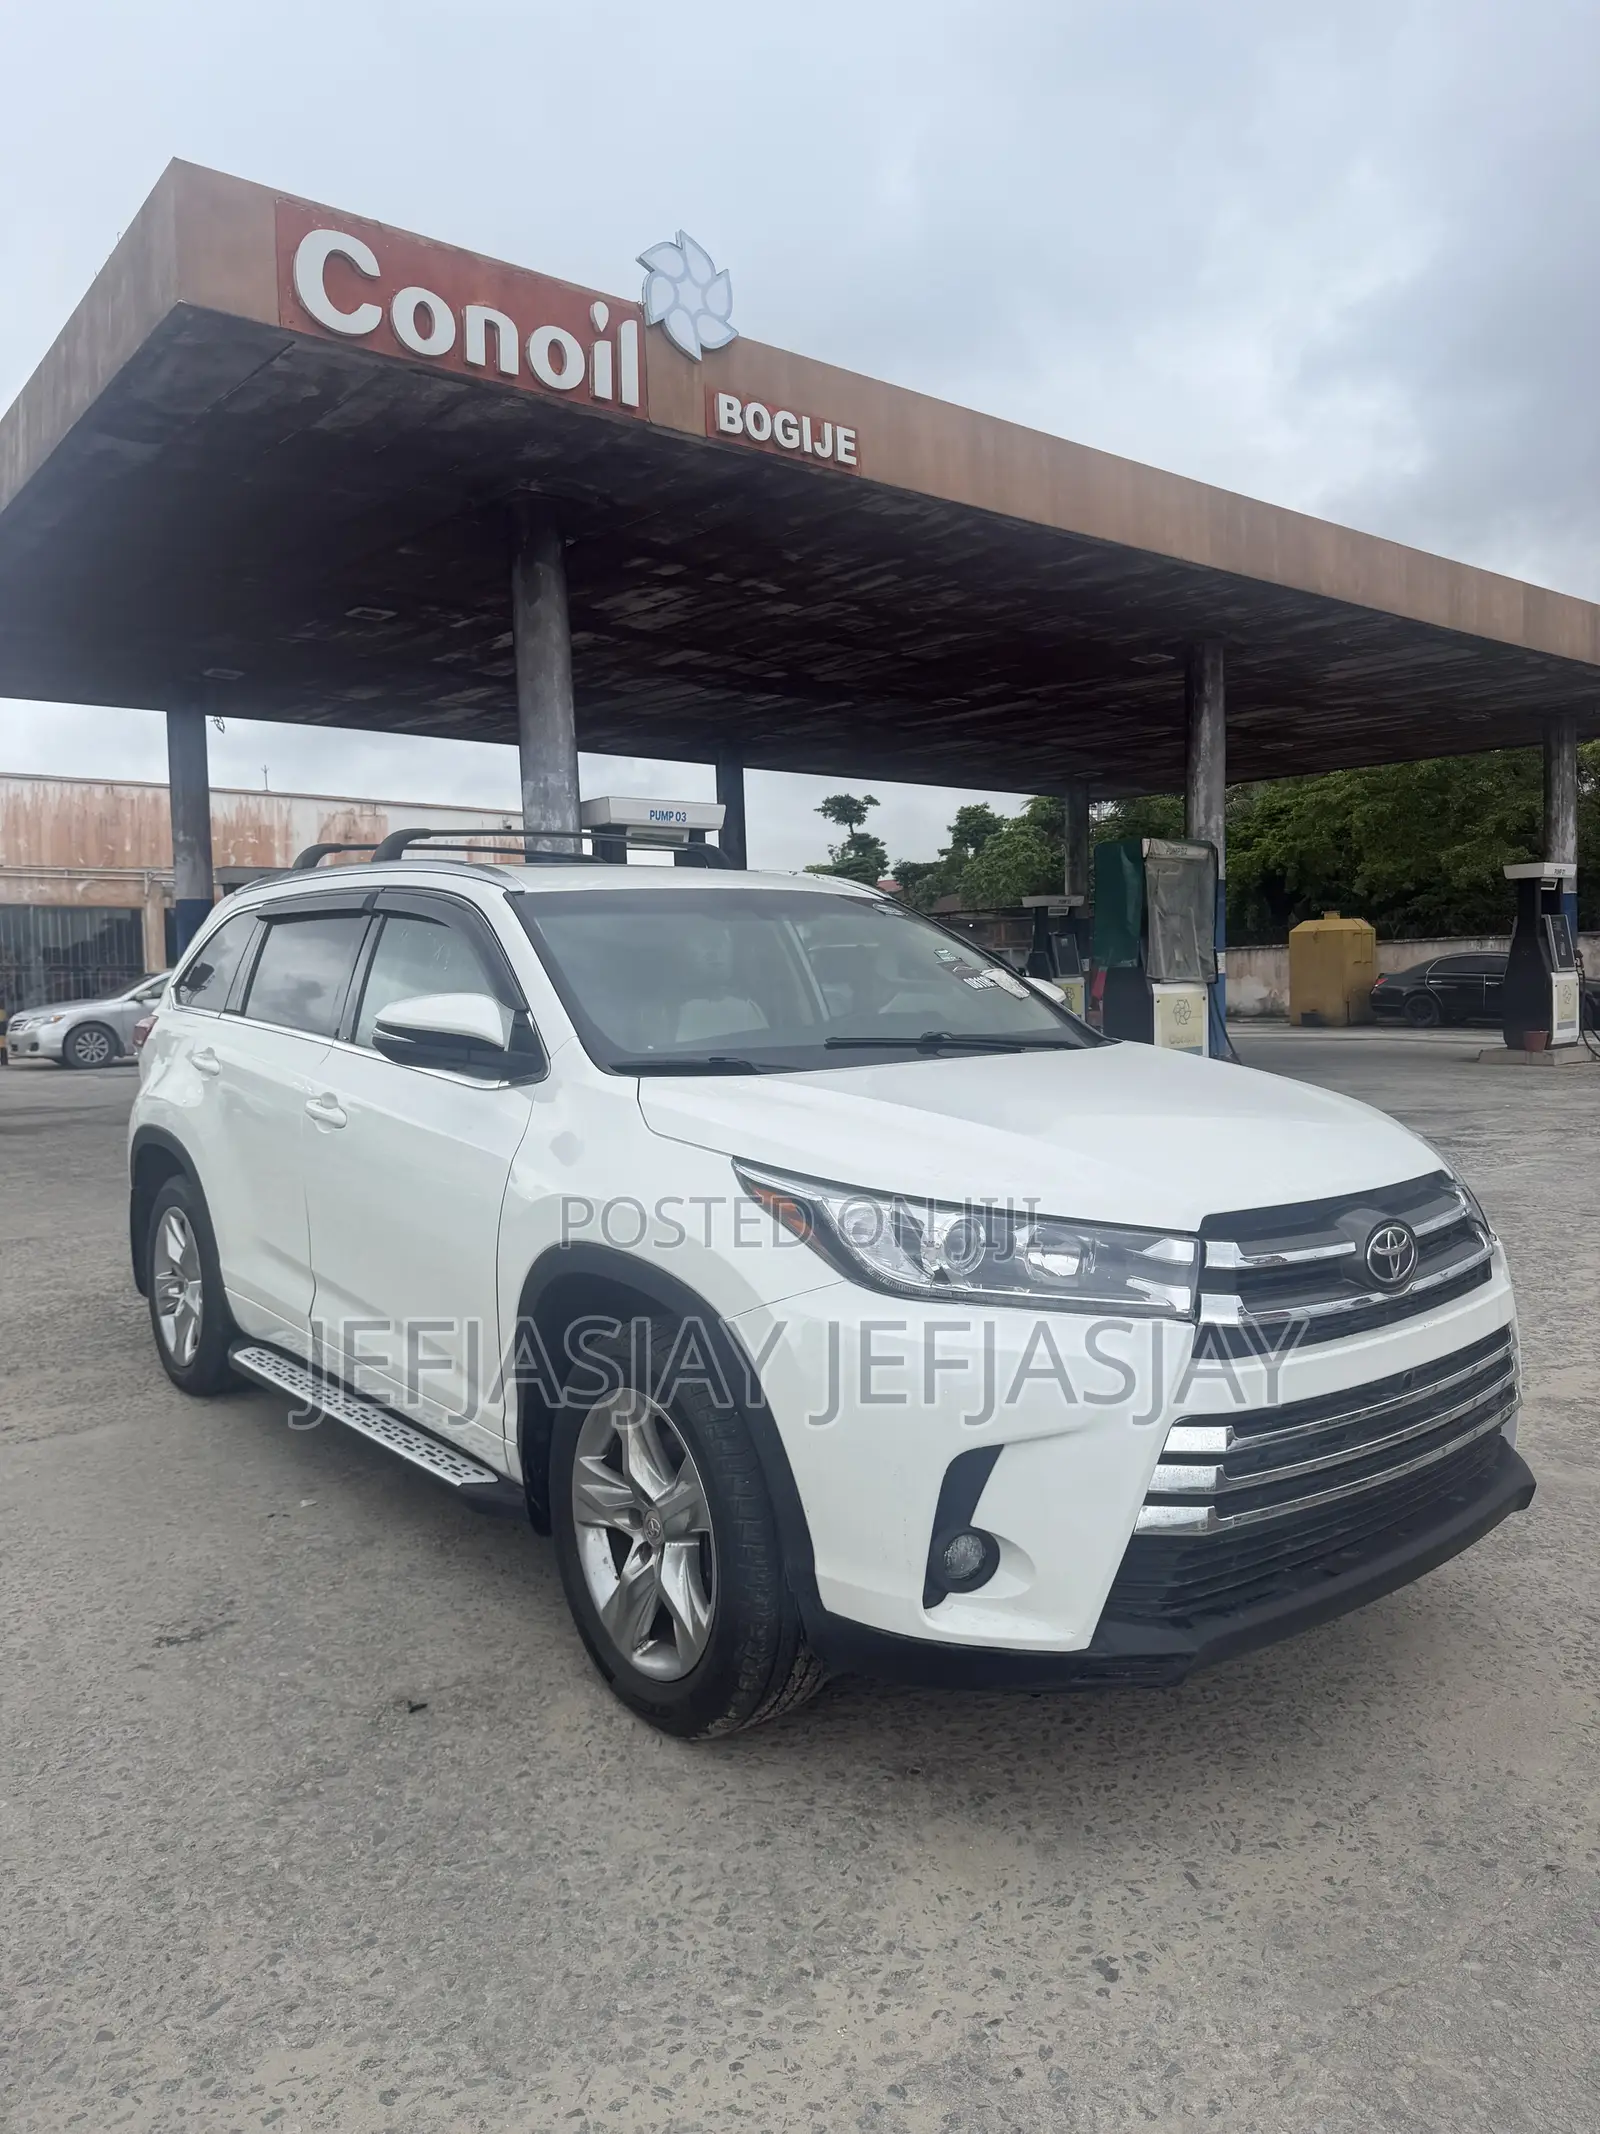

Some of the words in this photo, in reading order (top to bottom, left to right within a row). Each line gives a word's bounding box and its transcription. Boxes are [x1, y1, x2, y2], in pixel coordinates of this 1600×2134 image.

[294, 229, 640, 407] Conoil
[714, 392, 857, 466] BOGIJE
[649, 809, 674, 822] PUMP
[675, 811, 687, 823] 03
